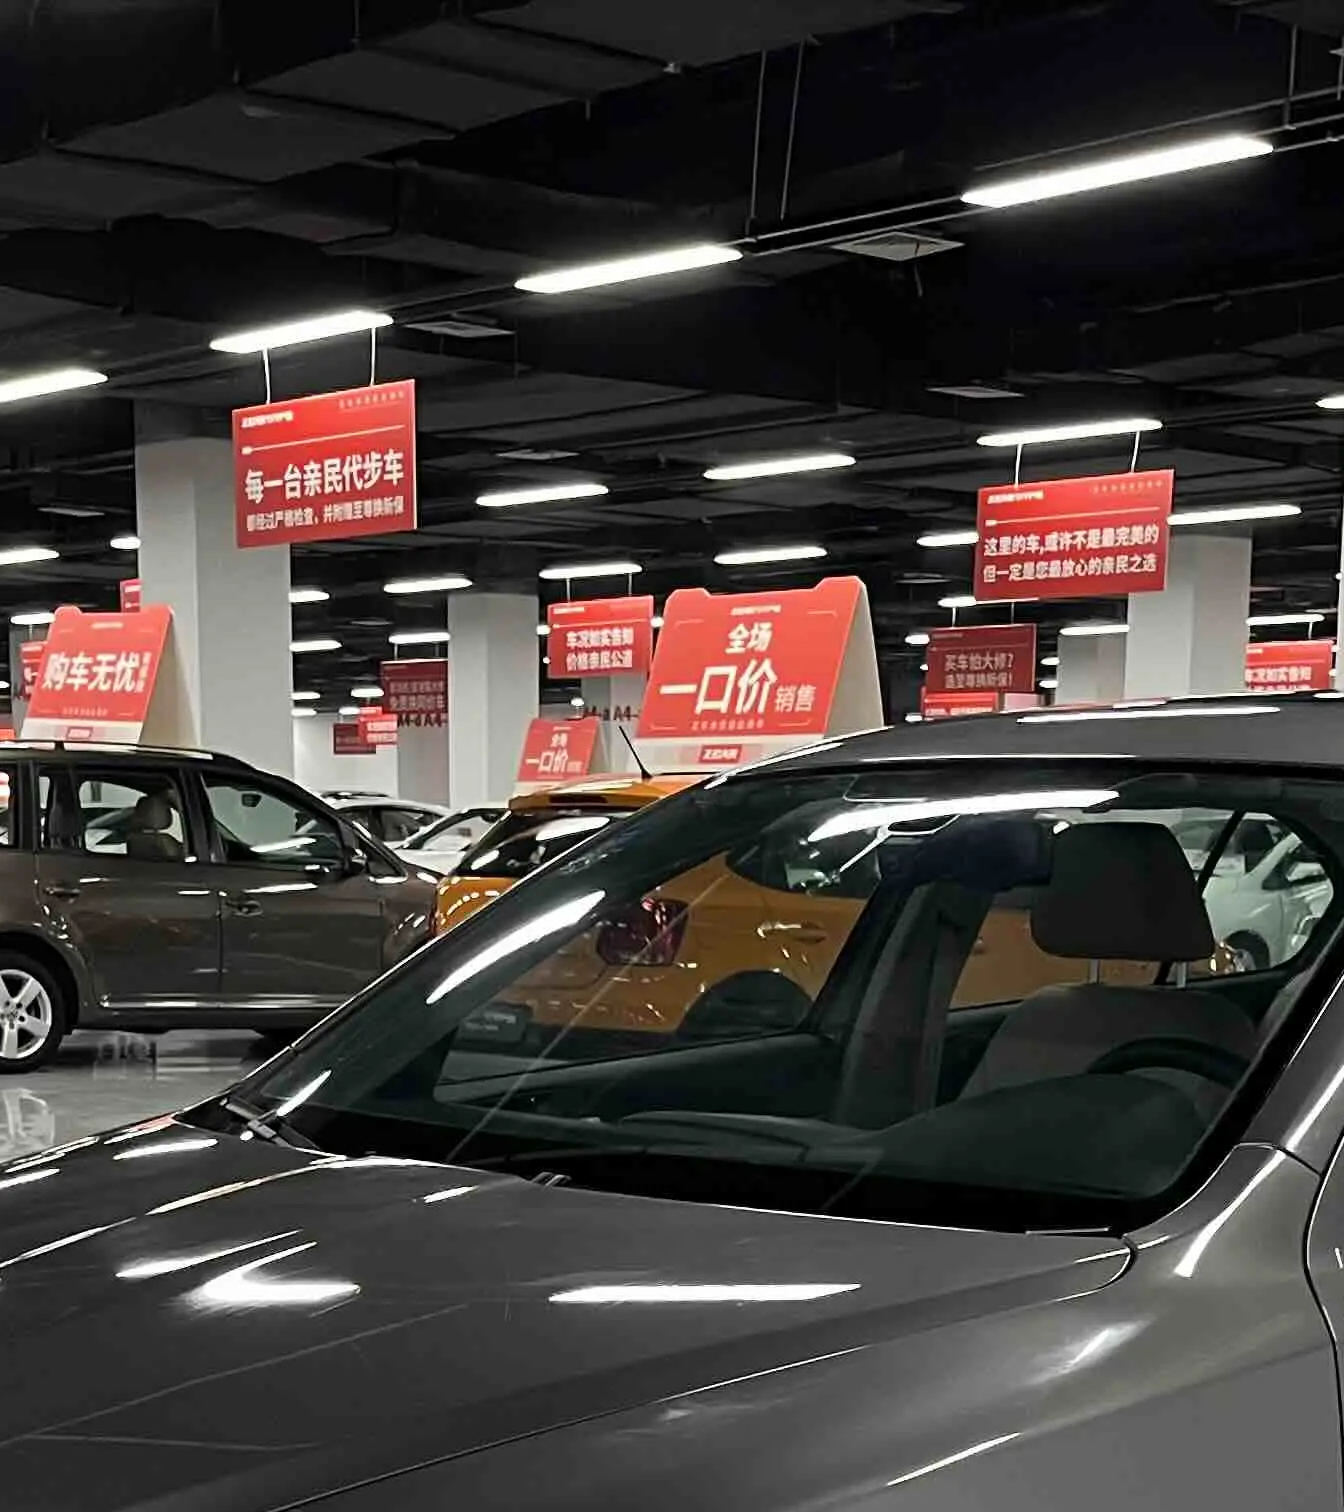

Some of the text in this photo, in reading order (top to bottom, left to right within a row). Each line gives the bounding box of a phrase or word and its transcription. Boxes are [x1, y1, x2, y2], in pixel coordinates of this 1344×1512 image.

[244, 449, 404, 504] 每一台亲民代步车
[724, 622, 773, 654] 全场
[42, 651, 142, 693] 购车无忧
[659, 658, 817, 714] 一口价 销售
